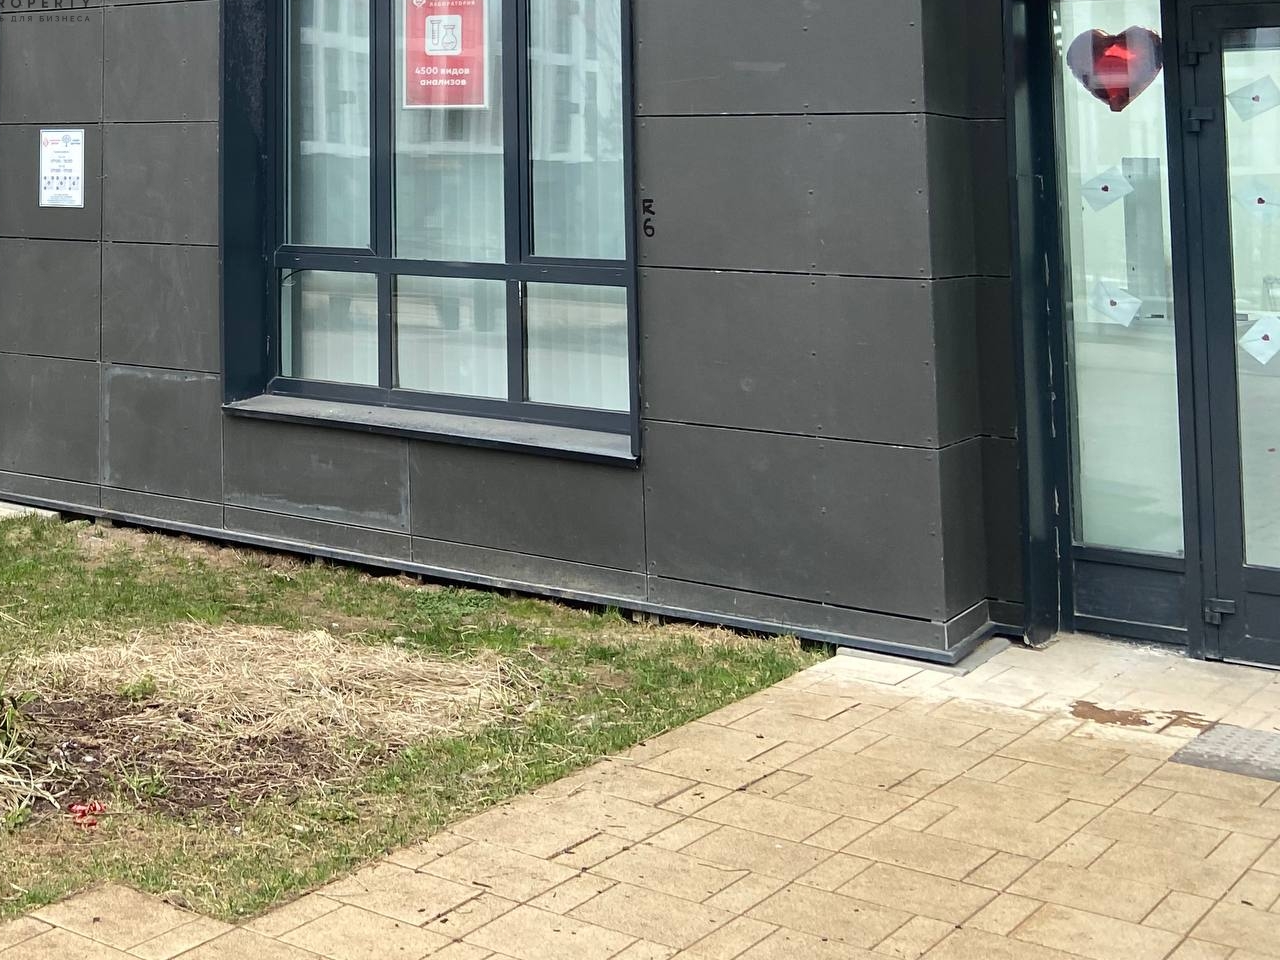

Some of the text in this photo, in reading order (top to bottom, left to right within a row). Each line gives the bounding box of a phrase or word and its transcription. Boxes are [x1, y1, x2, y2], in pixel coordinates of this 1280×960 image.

[415, 66, 470, 77] 4500 видов
[420, 78, 467, 86] анализов
